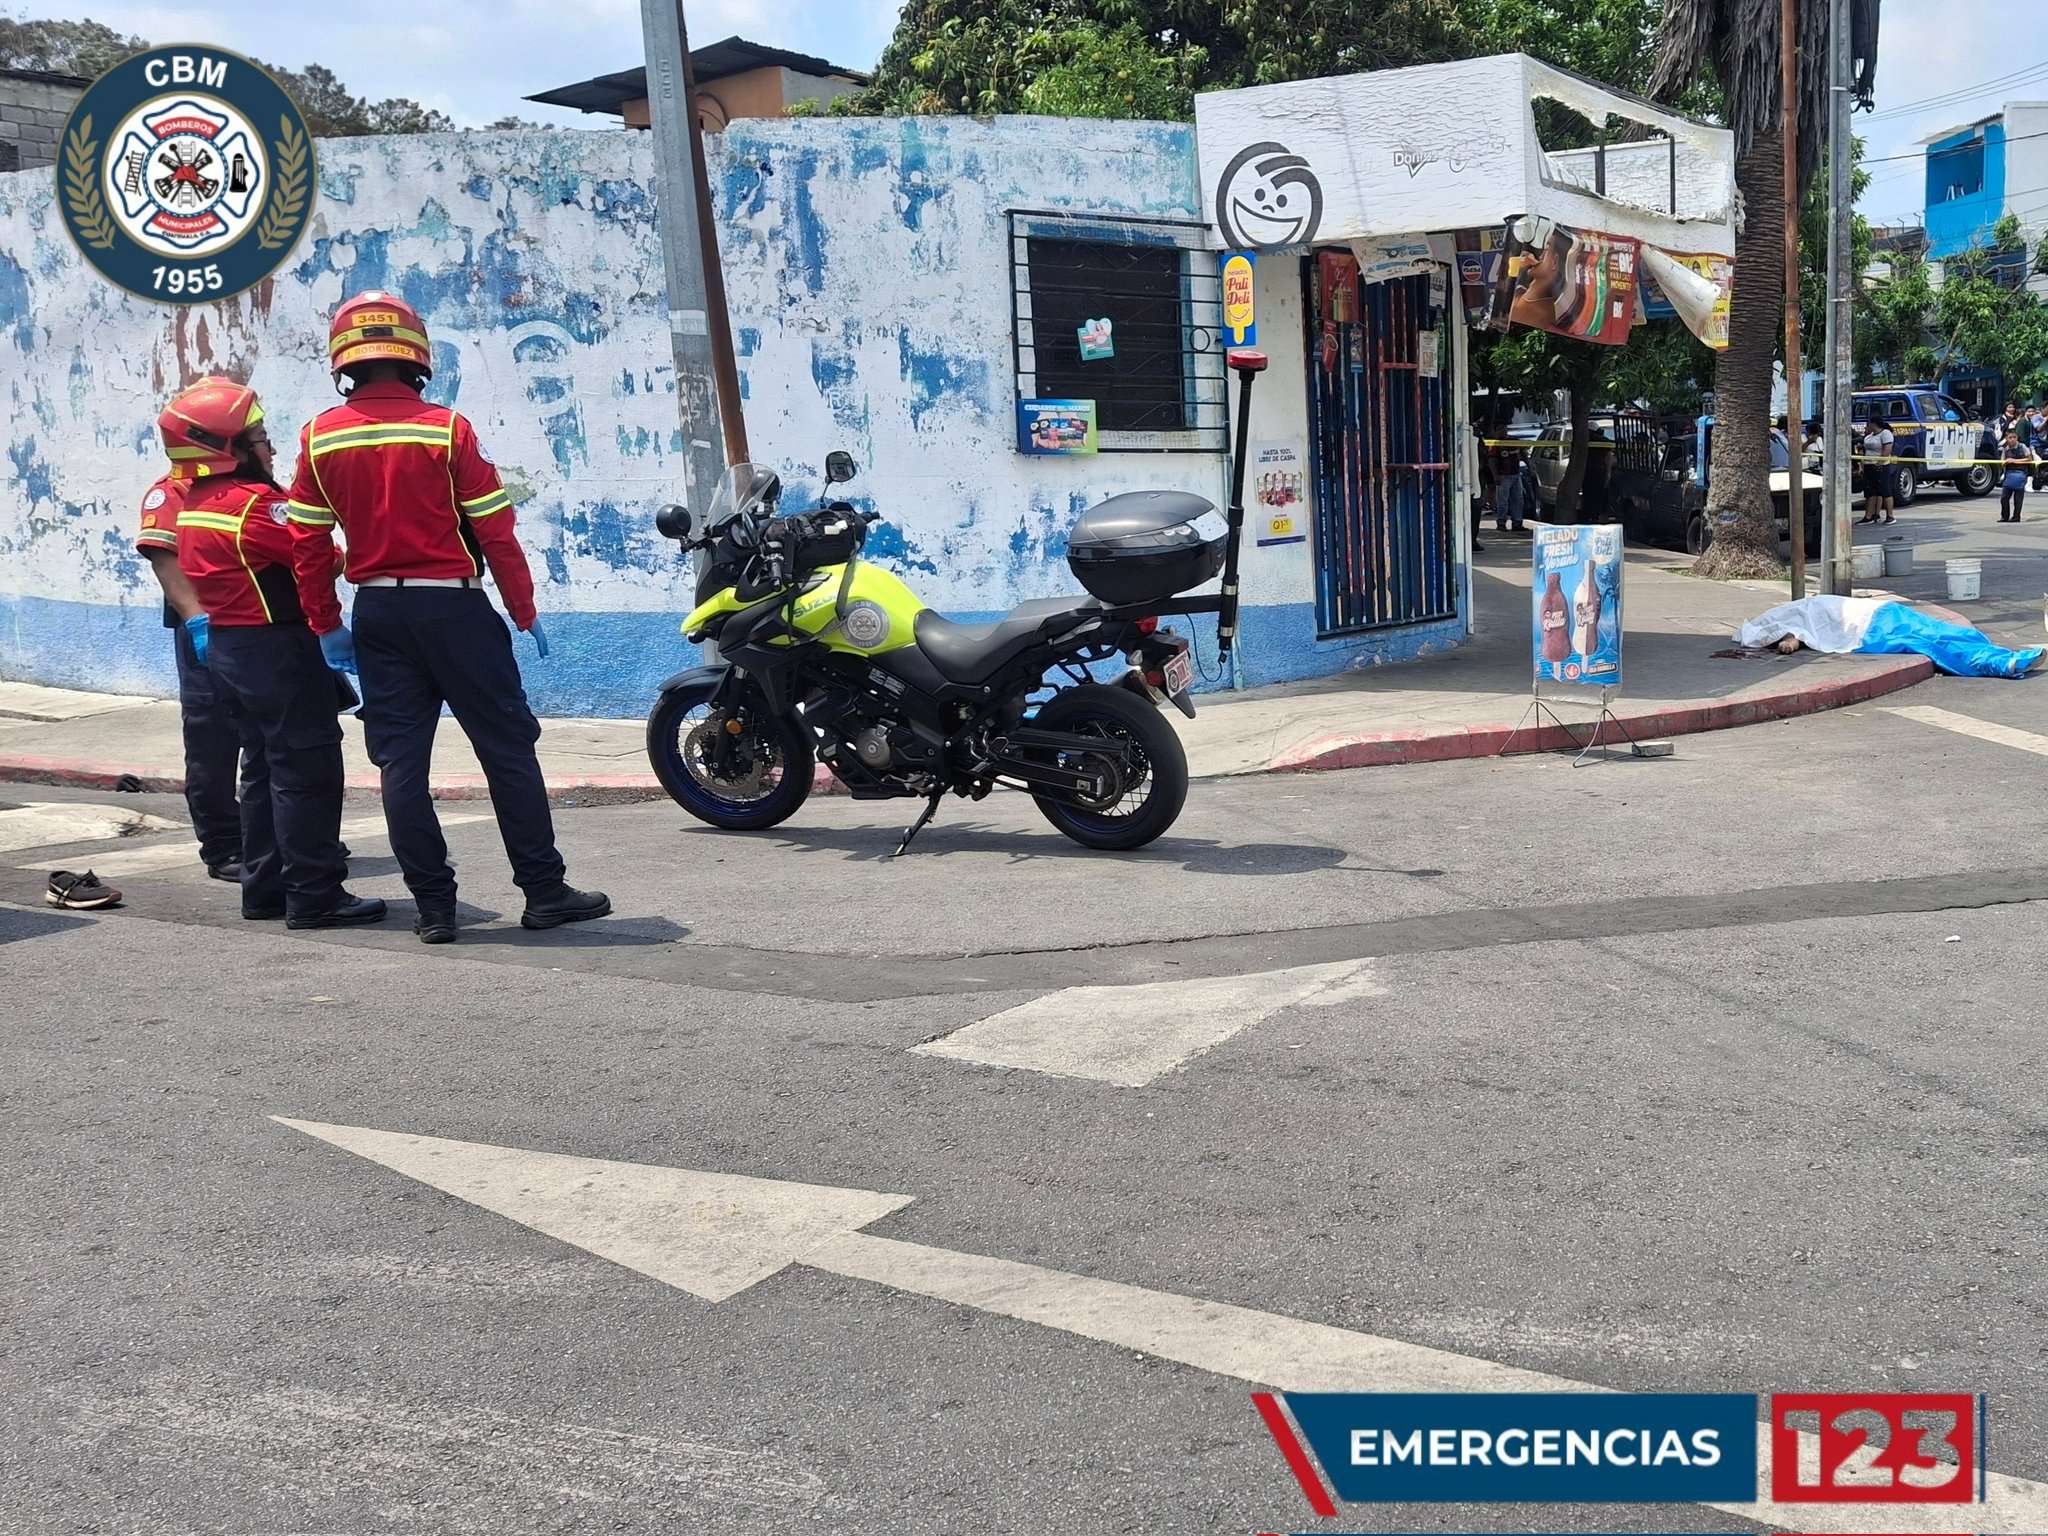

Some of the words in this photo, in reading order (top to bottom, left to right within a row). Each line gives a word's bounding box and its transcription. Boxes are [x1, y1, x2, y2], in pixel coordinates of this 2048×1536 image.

[1226, 277, 1248, 291] Pali
[1226, 291, 1250, 305] Deli
[359, 314, 393, 323] 3451
[1263, 448, 1279, 456] HASTA
[1538, 527, 1578, 545] HELADO
[1543, 541, 1574, 558] FRESH
[793, 594, 838, 618] SUZU
